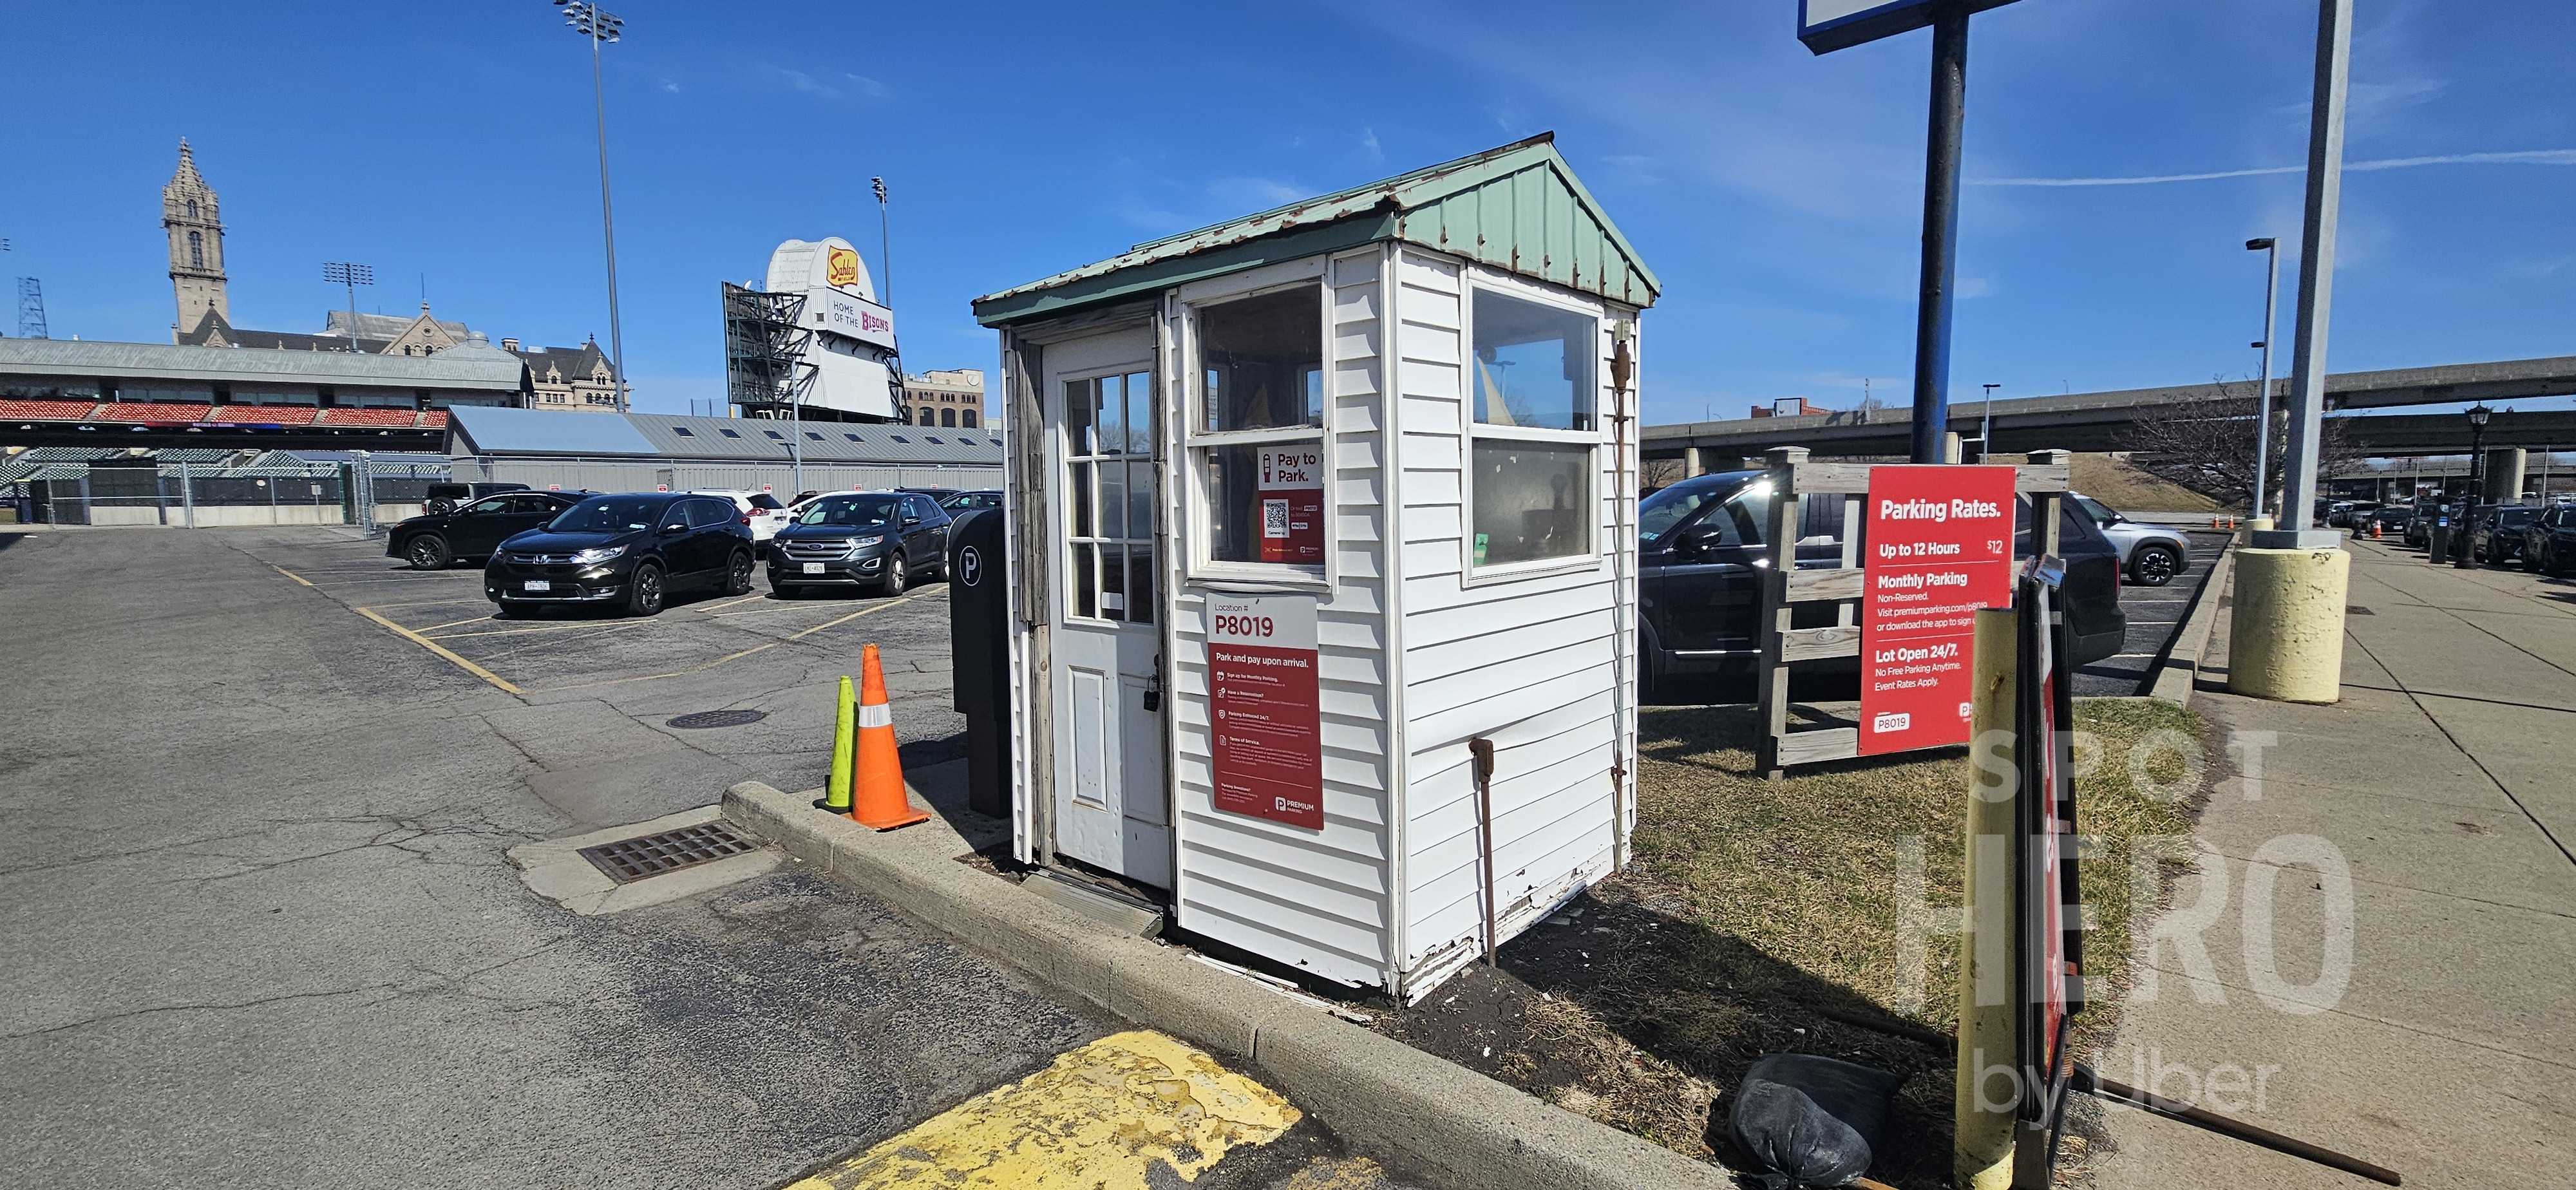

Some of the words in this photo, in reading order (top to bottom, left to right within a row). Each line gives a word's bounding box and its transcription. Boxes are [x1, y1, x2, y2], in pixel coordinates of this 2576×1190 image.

[831, 252, 855, 279] Sahlen
[834, 300, 853, 315] HOME
[835, 313, 843, 322] OF
[846, 316, 858, 328] THE
[861, 310, 889, 332] BISONS
[1278, 453, 1300, 468] Pay
[1303, 452, 1316, 465] to
[1278, 469, 1309, 482] Park.
[1880, 498, 1947, 522] Parking
[1951, 499, 2001, 518] Rates.
[1880, 544, 1896, 558] Up
[1899, 543, 1911, 556] to
[1913, 543, 1926, 555] 12
[1928, 542, 1960, 554] Hours
[1987, 540, 2002, 554] $12
[965, 552, 977, 579] P
[1879, 574, 1924, 589] Monthly
[1927, 572, 1967, 586] Parking
[1878, 592, 1929, 603] Non-Reserved.
[1215, 603, 1242, 612] Location
[1877, 608, 1893, 617] Visit
[1215, 614, 1273, 638] P8019
[1886, 620, 1920, 630] download
[1922, 619, 1933, 628] the
[1935, 620, 1948, 630] app
[1957, 618, 1971, 627] sign
[1216, 652, 1231, 662] Park
[1233, 653, 1246, 663] and
[1247, 657, 1262, 666] pay
[1263, 657, 1282, 666] upon
[1283, 657, 1309, 668] arrival.
[1875, 650, 1895, 663] Lot
[1898, 647, 1927, 661] Open
[1930, 643, 1958, 658] 24/7.
[1875, 668, 1886, 677] No
[1888, 667, 1904, 675] Free
[1905, 665, 1931, 675] Parking
[1932, 661, 1961, 672] Anytime.
[1875, 683, 1895, 691] Event
[1897, 680, 1916, 688] Rates
[1917, 677, 1938, 688] Apply.
[1879, 717, 1906, 729] P8019
[1287, 800, 1314, 811] PREMIUM
